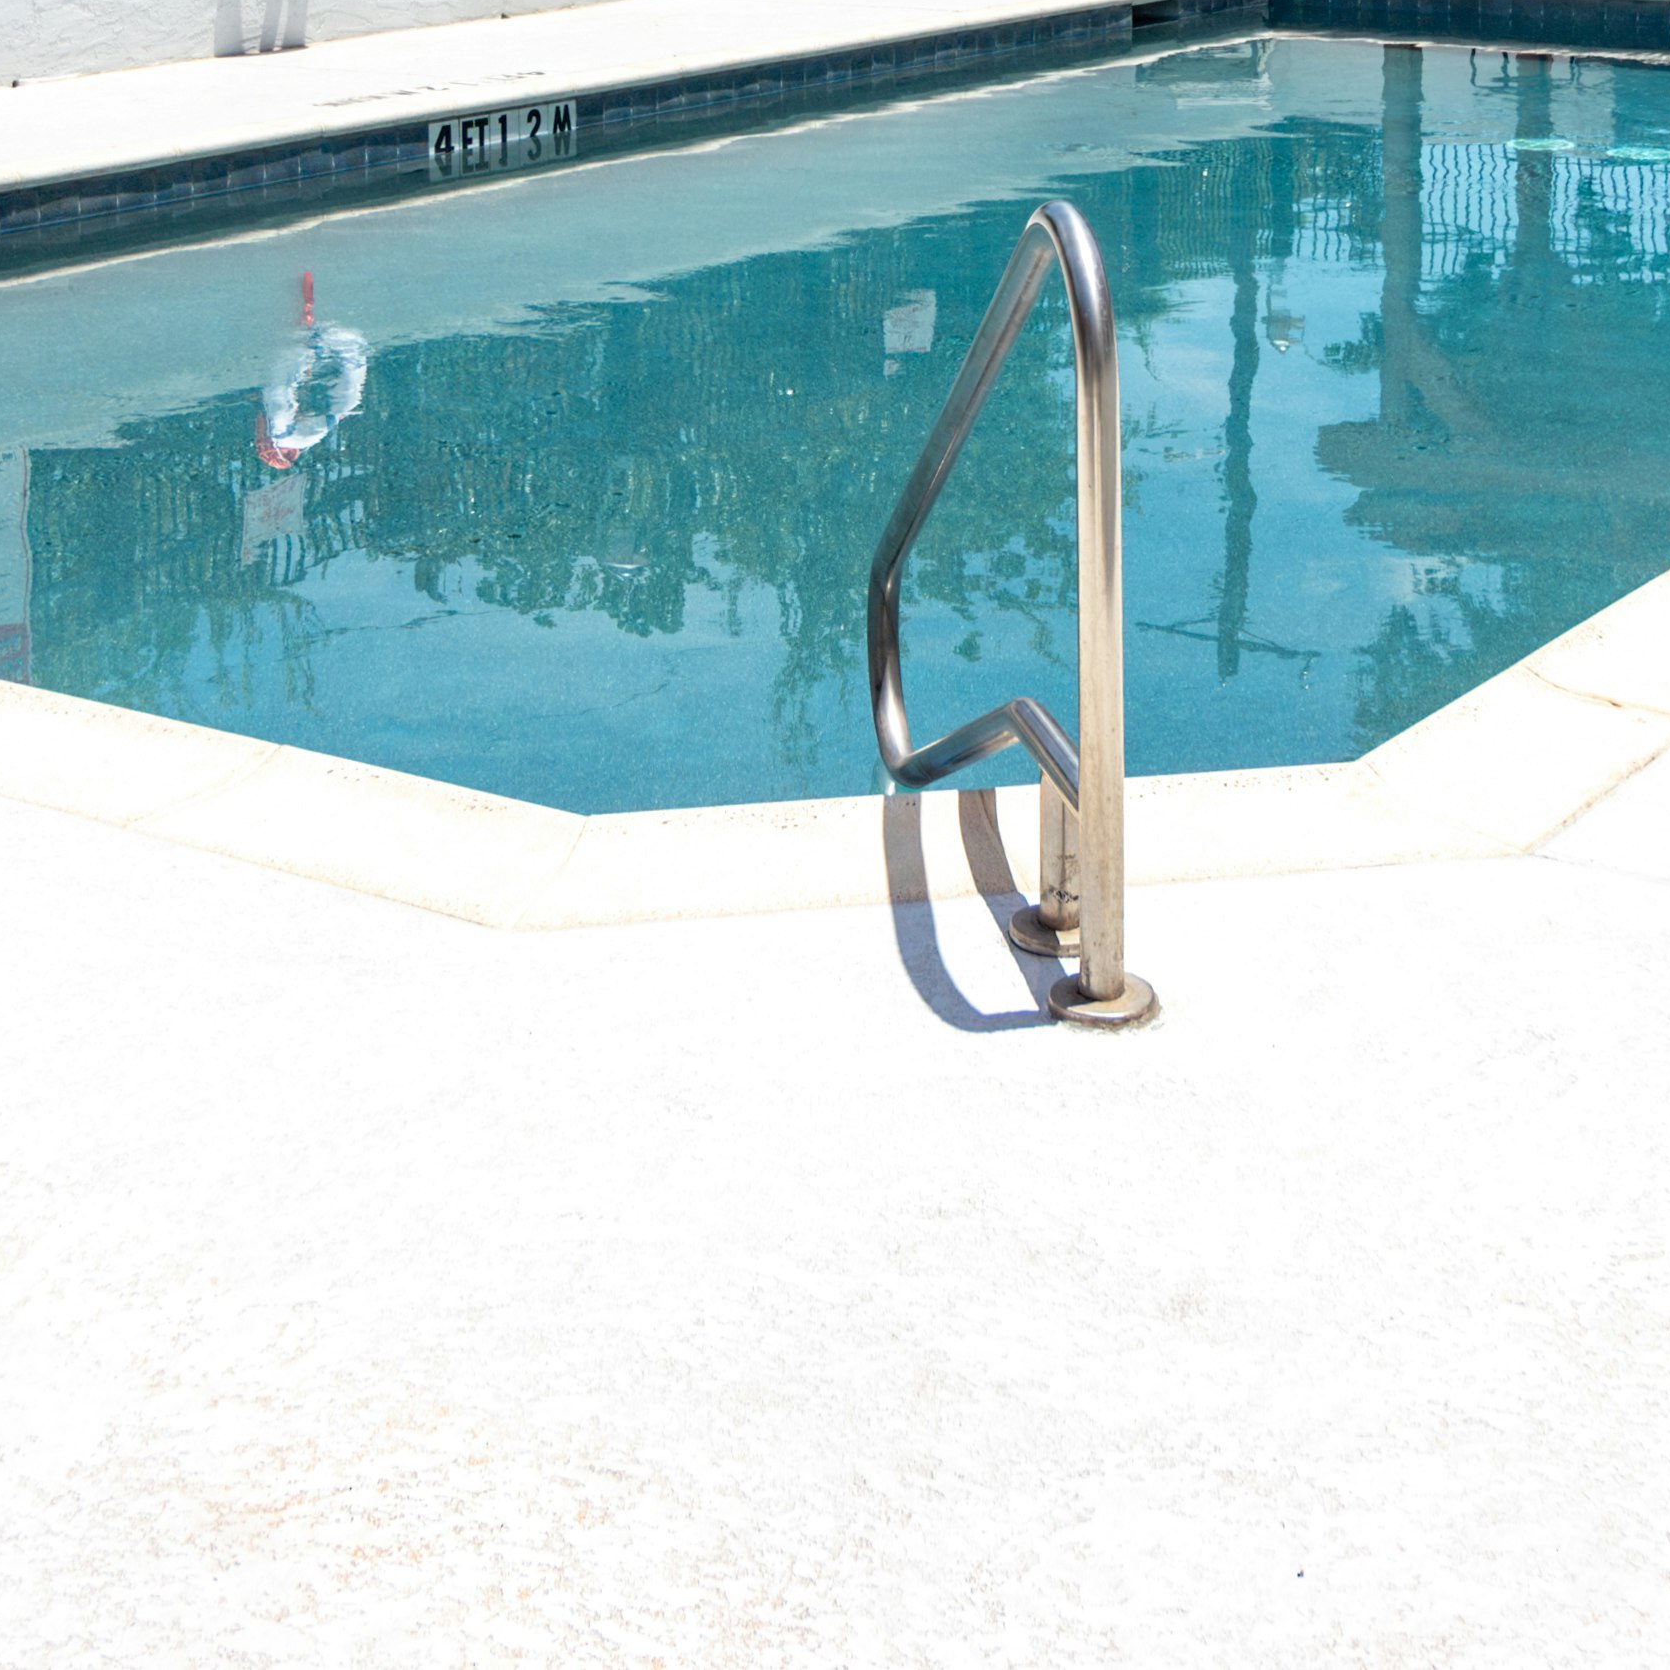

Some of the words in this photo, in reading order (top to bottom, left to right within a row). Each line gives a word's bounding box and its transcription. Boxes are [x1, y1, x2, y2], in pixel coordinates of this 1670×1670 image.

[434, 124, 454, 153] 4
[462, 116, 488, 149] FT
[553, 104, 572, 134] M
